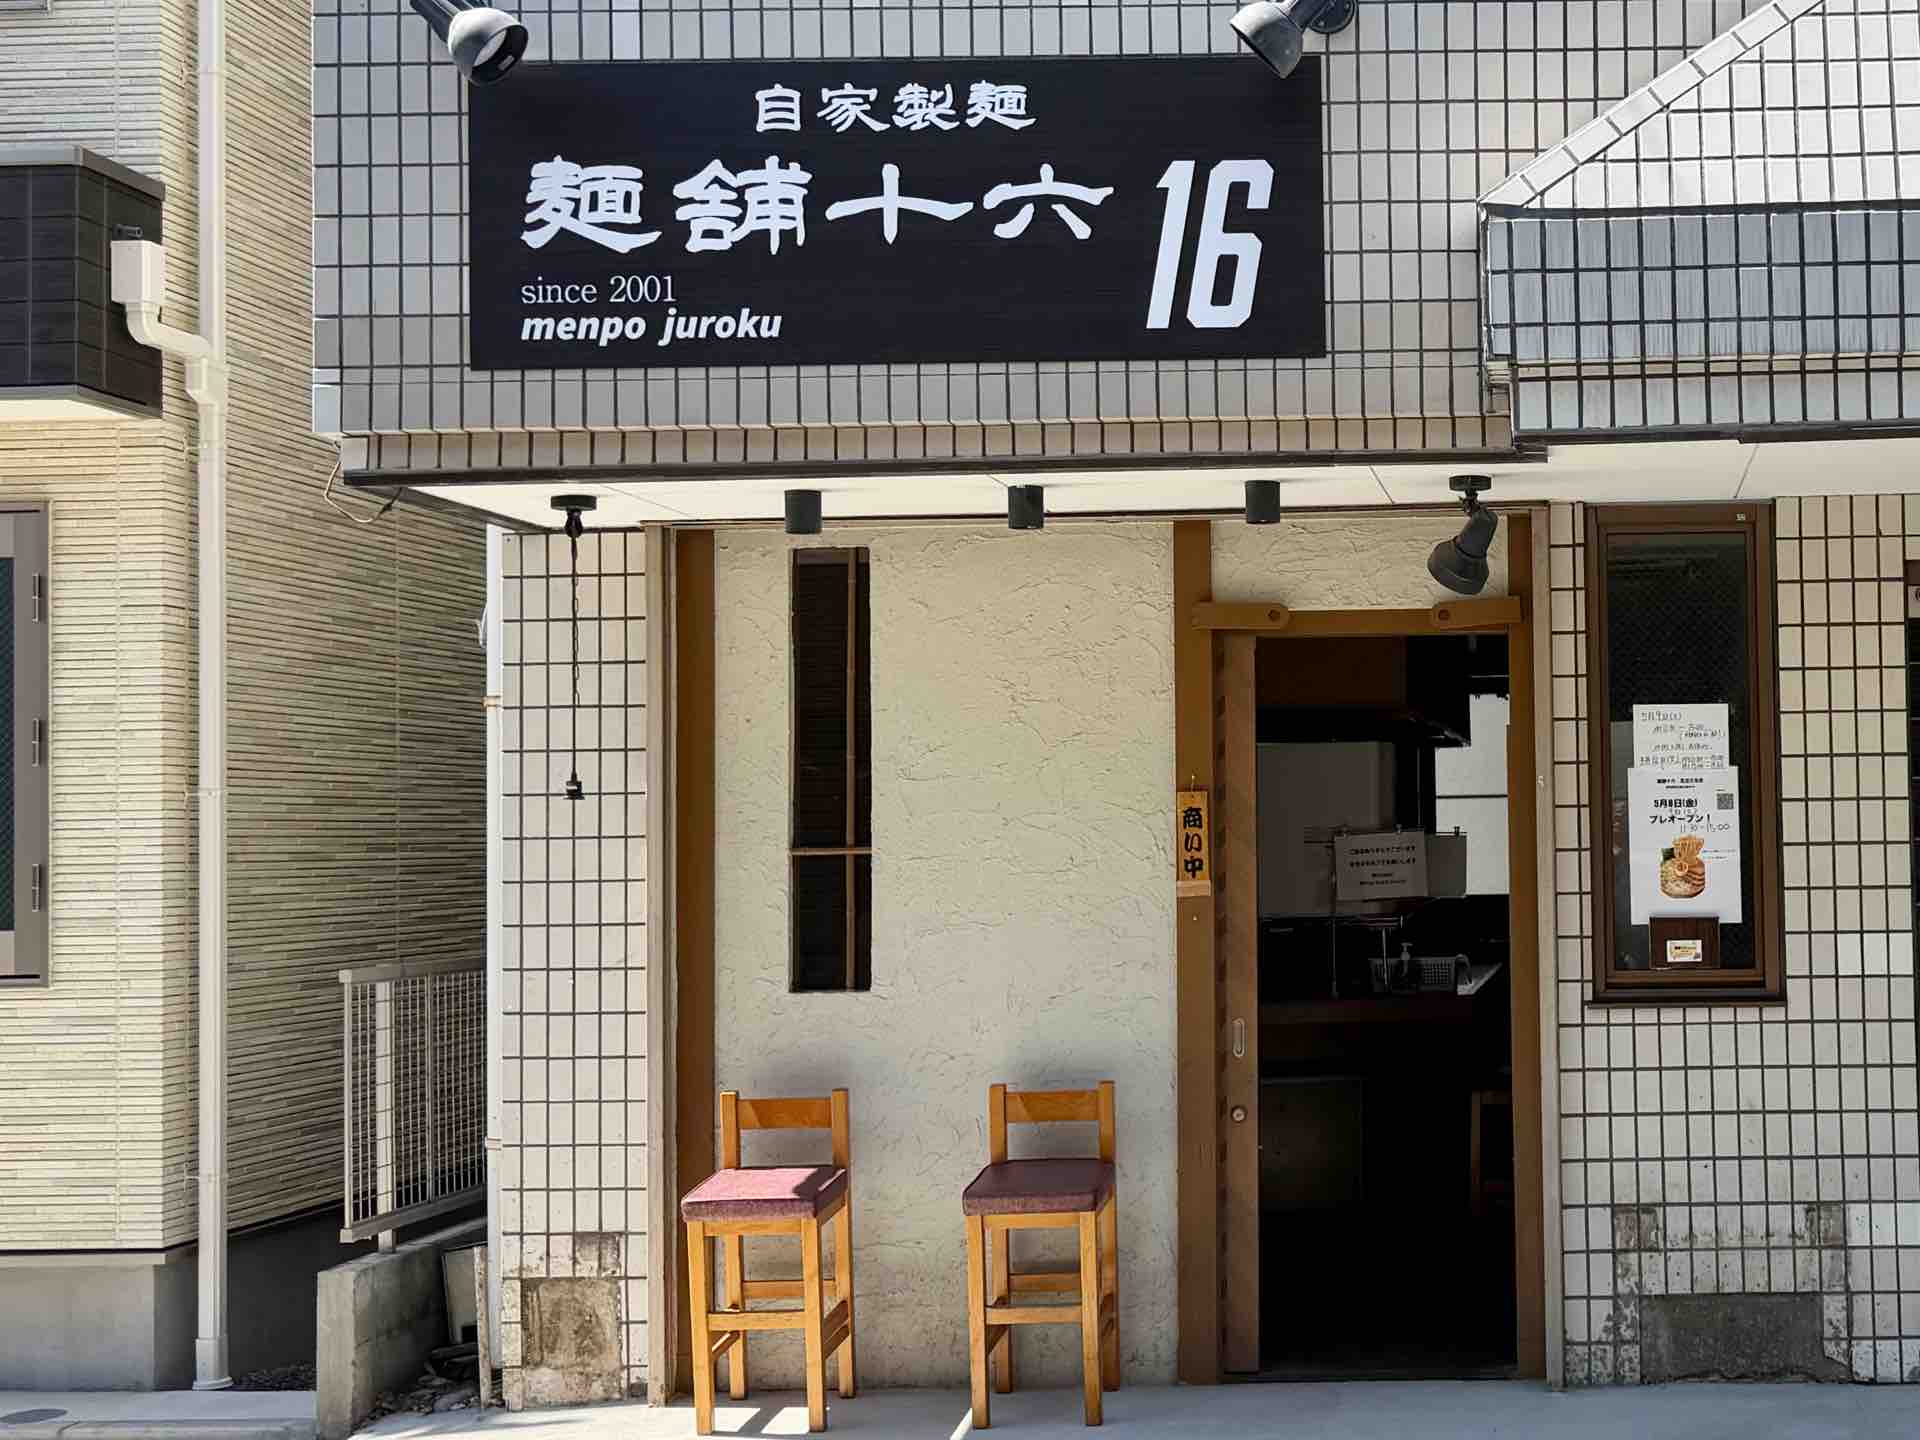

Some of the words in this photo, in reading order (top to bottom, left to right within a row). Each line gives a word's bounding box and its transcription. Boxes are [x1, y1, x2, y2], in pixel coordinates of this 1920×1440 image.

[754, 79, 1037, 133] 自家製麺
[520, 154, 1115, 256] 麺舗十六
[1145, 159, 1275, 329] 16
[521, 276, 597, 304] since
[609, 275, 676, 303] 2001
[520, 316, 647, 347] menpo
[657, 307, 782, 347] juroku
[1183, 807, 1203, 879] 商い中
